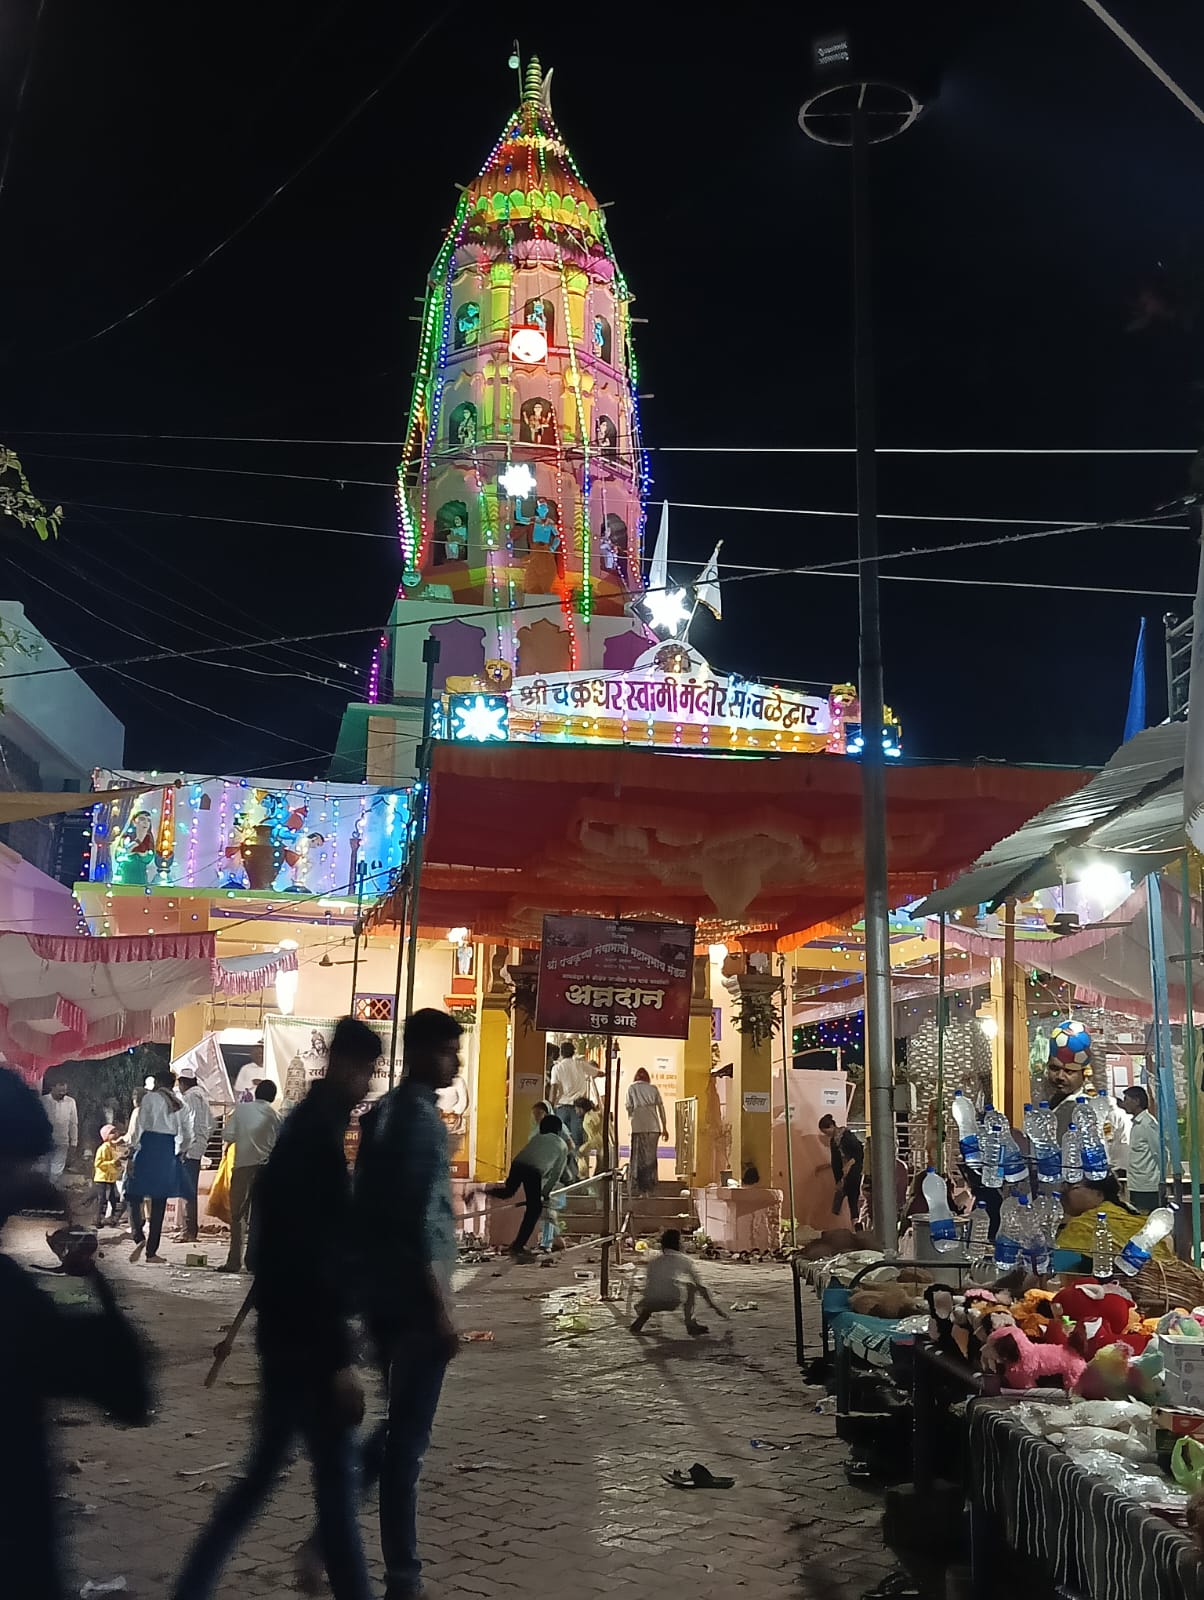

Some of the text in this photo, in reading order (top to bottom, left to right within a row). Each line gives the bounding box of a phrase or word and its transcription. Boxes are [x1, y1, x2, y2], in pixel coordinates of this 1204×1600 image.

[520, 679, 548, 706] श्री
[550, 679, 623, 710] चक्रधर
[625, 676, 678, 712] स्वामी
[565, 984, 665, 1010] अन्नदान
[614, 1011, 638, 1029] आहे
